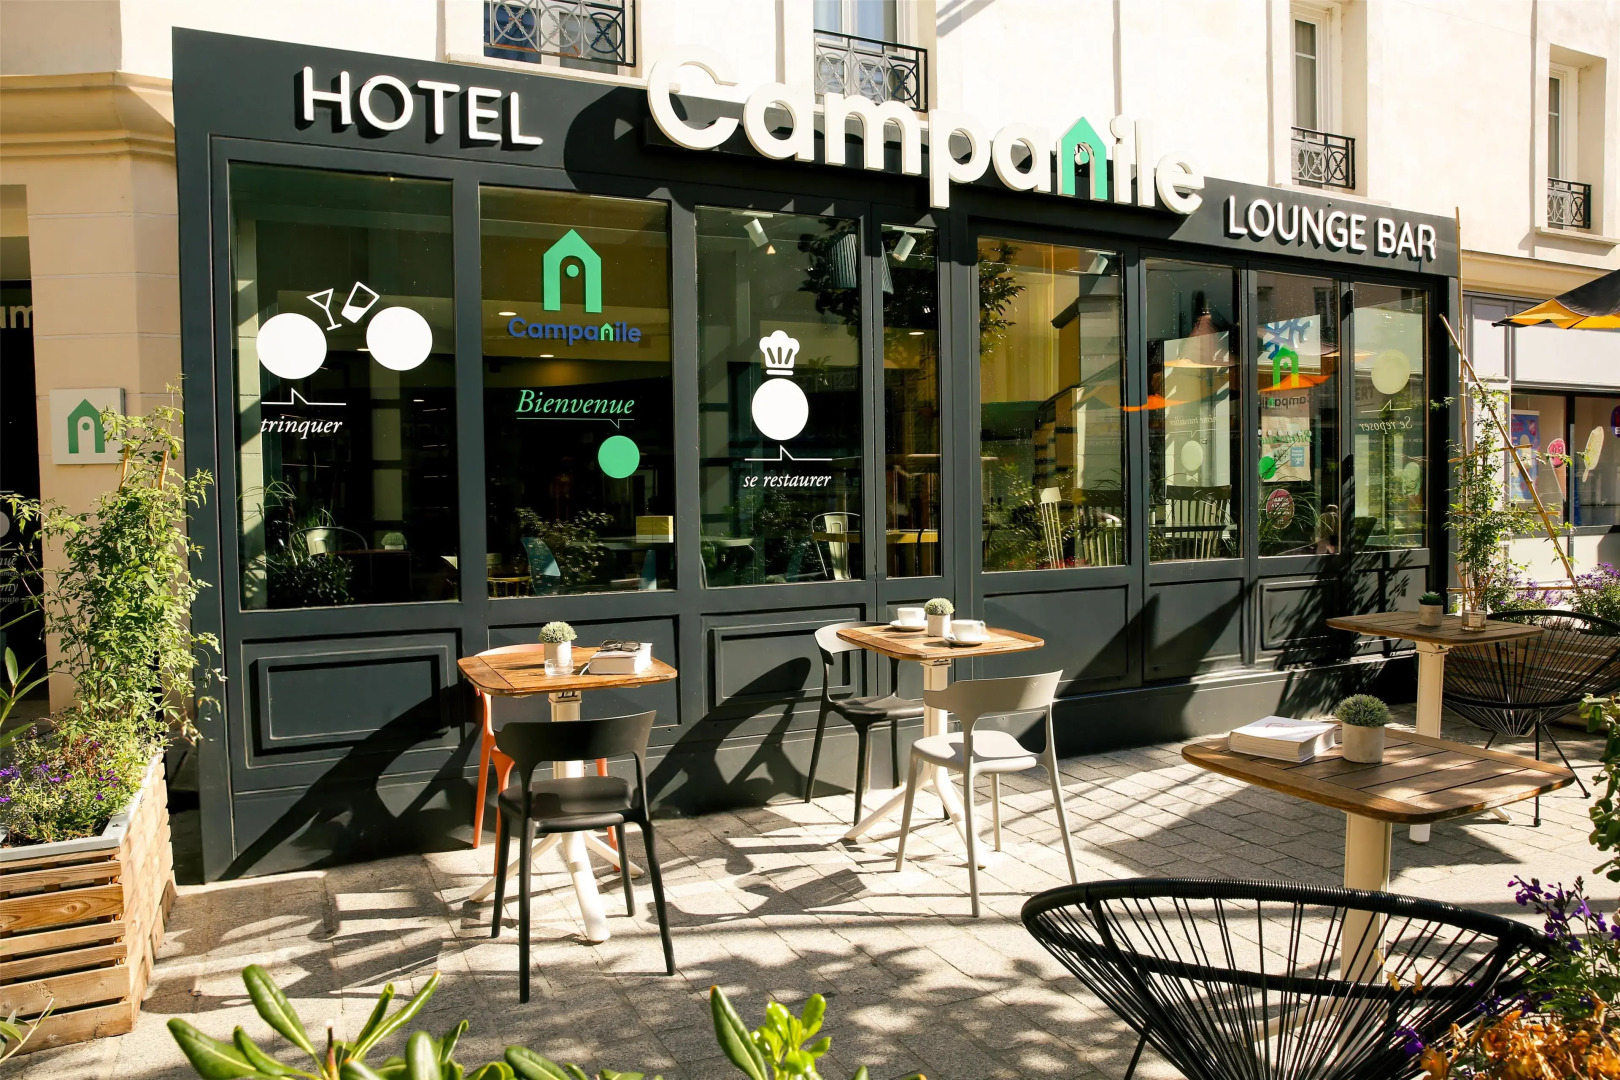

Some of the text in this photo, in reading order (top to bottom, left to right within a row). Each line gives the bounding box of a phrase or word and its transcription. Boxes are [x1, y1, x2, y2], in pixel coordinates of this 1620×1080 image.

[302, 66, 544, 147] HOTEL
[646, 47, 1205, 215] Campanile
[1228, 194, 1437, 260] LOUNGE BAR
[508, 317, 642, 346] Campanile
[515, 389, 635, 414] Bienvenue
[260, 414, 343, 440] trinquer
[743, 473, 832, 488] se restaurer
